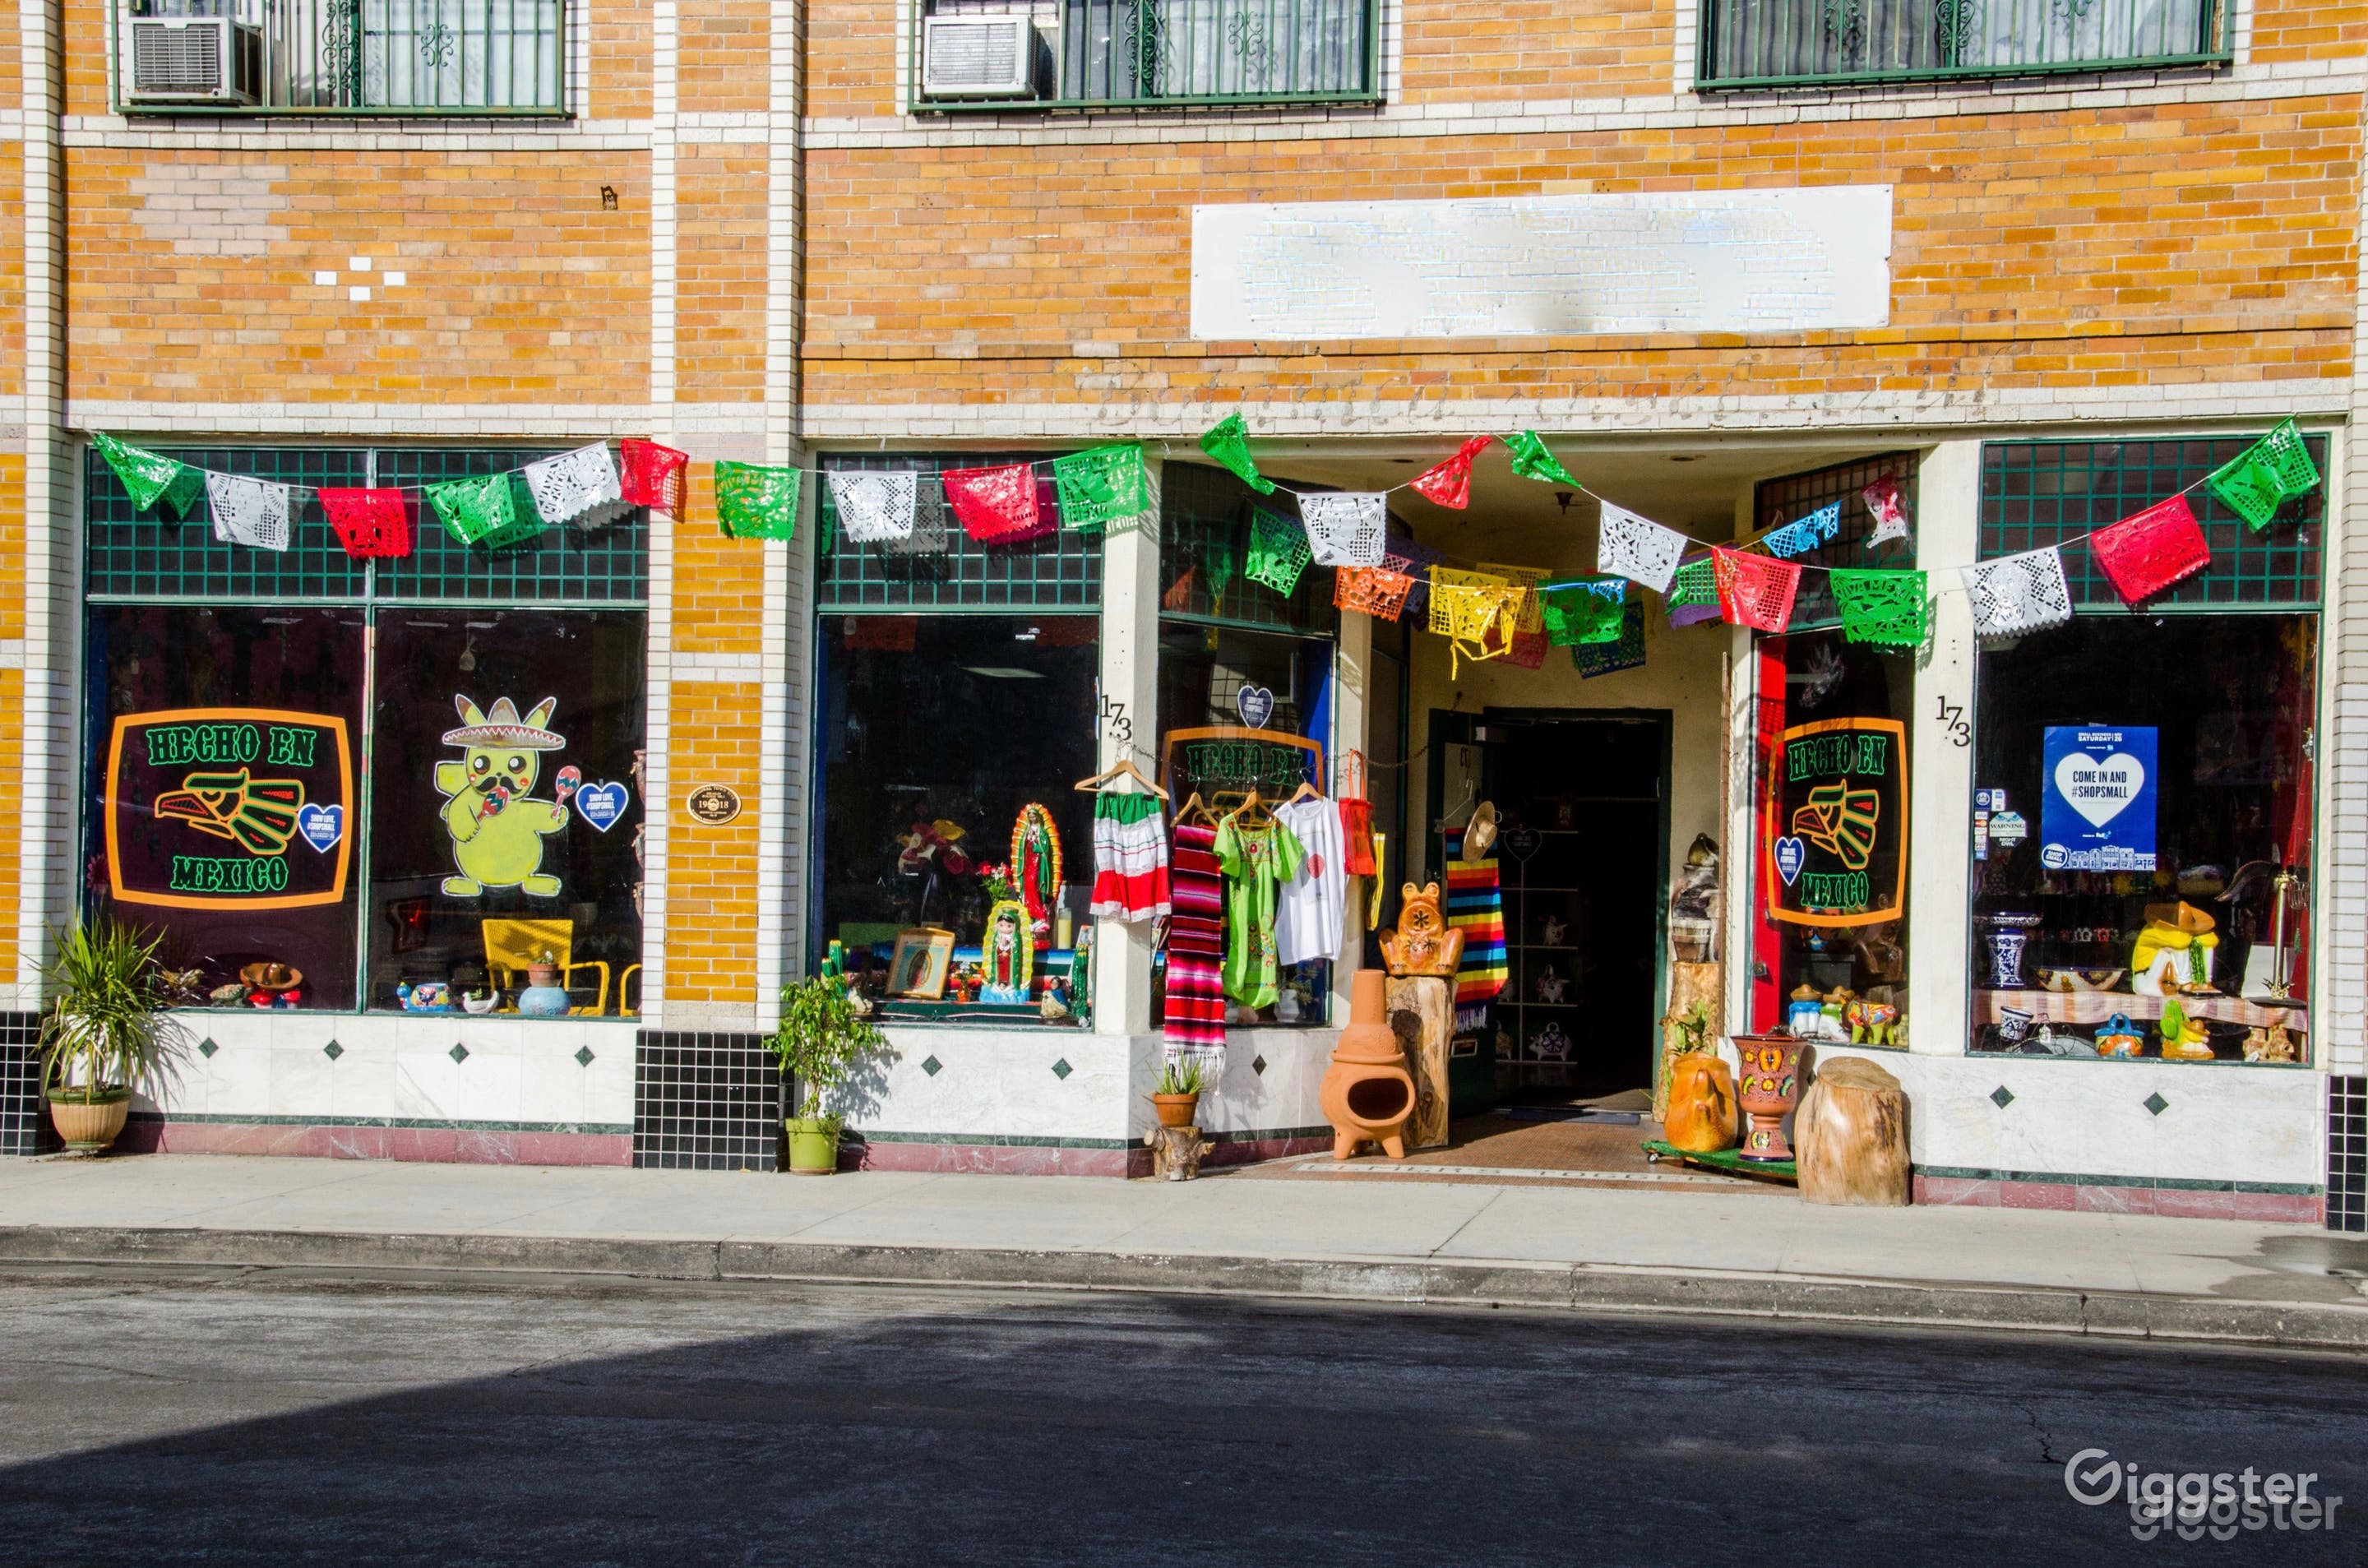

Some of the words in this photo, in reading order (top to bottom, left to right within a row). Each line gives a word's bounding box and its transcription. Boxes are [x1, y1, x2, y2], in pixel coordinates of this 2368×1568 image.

[1100, 694, 1132, 741] 173
[1936, 696, 1971, 747] 173
[146, 724, 260, 766] HECHO
[268, 727, 317, 766] EN
[1788, 735, 1853, 781] HECHO
[1857, 735, 1886, 775] EN
[1186, 743, 1265, 782] HECHO
[1270, 747, 1303, 788] EN
[2073, 770, 2097, 784] COME
[2098, 770, 2108, 784] IN
[2110, 770, 2127, 784] AND
[699, 800, 708, 808] 19
[719, 801, 729, 809] 18
[2072, 785, 2128, 798] #SHOPSMALL
[170, 856, 289, 892] MEXICO
[1801, 871, 1870, 909] MEXICO
